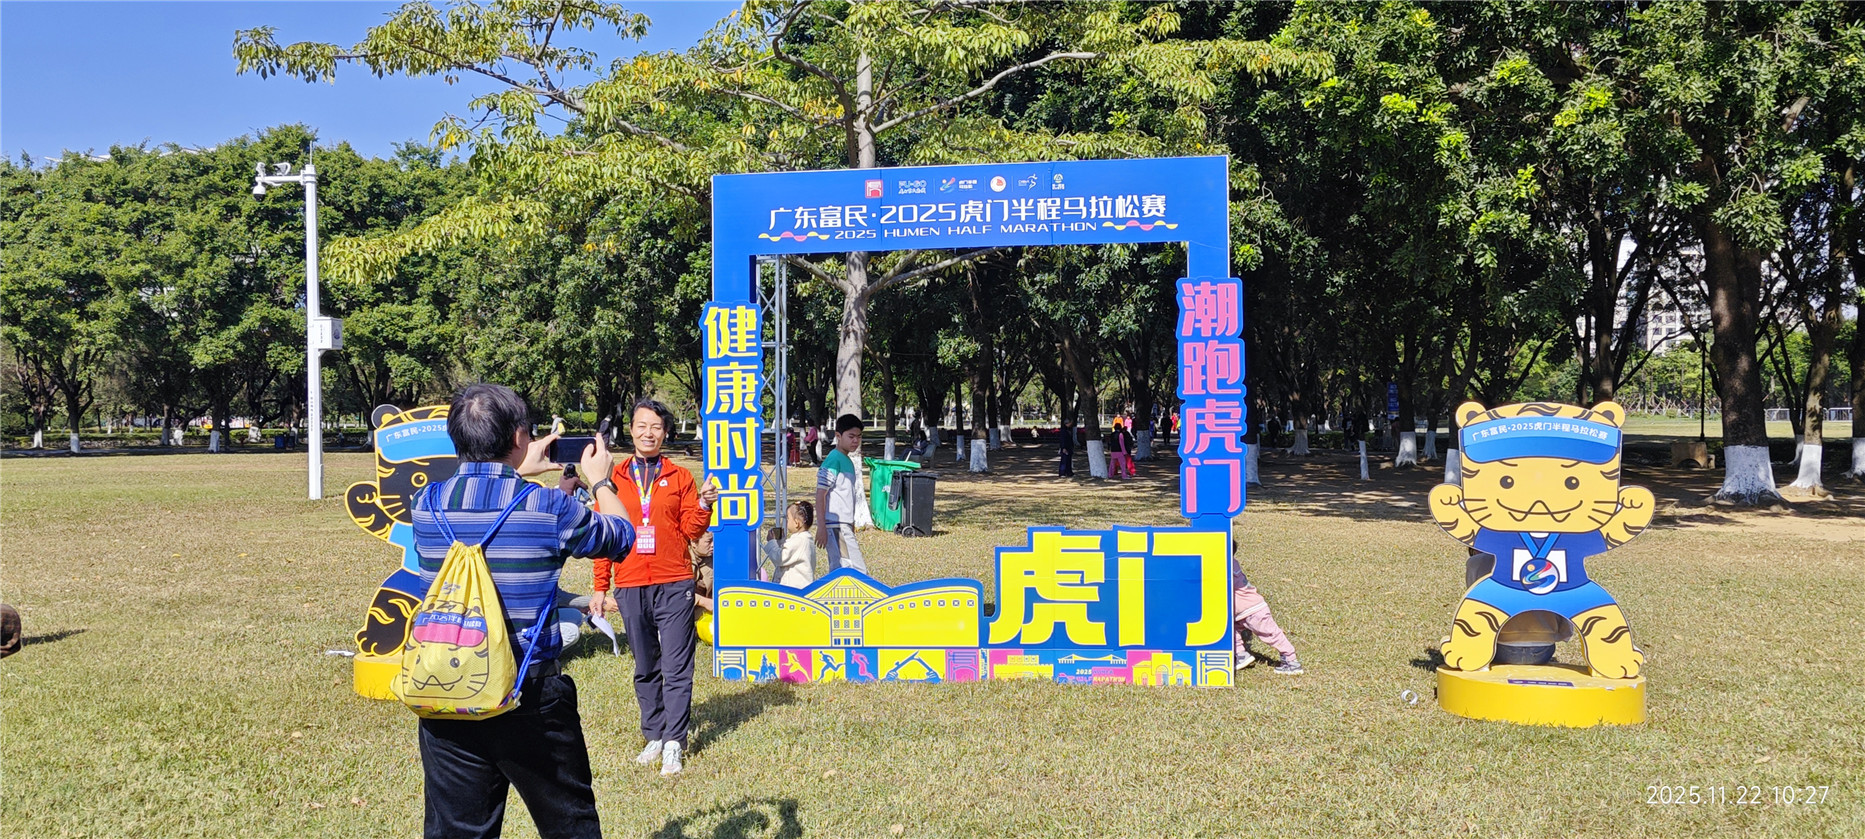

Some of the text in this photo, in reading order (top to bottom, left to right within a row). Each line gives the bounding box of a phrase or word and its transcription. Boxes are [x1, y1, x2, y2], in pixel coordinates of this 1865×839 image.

[769, 194, 1167, 231] 广东富民·2025虎门半程马拉松赛
[834, 221, 1097, 240] 2025 HUMEN HALF MARATHON
[703, 305, 760, 527] 健康时尚
[1181, 281, 1243, 513] 潮跑虎门
[988, 530, 1228, 647] 虎门
